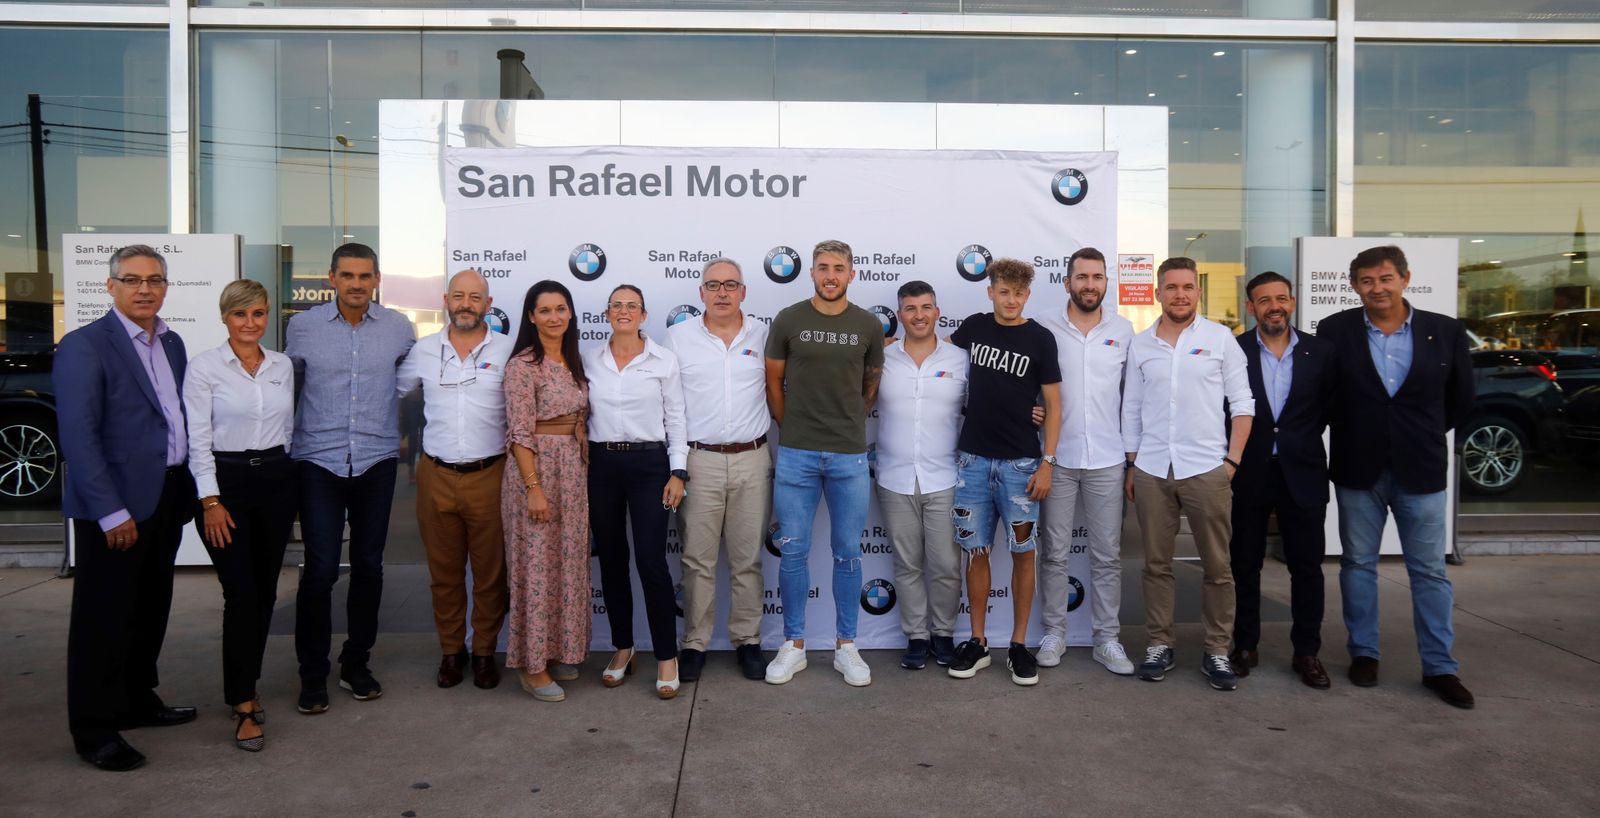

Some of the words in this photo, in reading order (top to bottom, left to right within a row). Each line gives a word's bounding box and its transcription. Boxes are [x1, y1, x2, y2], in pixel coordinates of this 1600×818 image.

[458, 165, 535, 198] San
[549, 163, 673, 197] Rafael
[687, 165, 807, 198] Motor
[75, 245, 95, 255] San
[97, 245, 119, 255] Rafa
[163, 245, 183, 254] S.L.
[452, 250, 480, 262] San
[484, 250, 527, 262] Rafael
[648, 250, 675, 262] San
[853, 256, 869, 265] an
[873, 253, 916, 265] Rafael
[1034, 256, 1059, 267] San
[665, 267, 701, 279] Moto
[859, 269, 901, 282] Motor
[1311, 271, 1338, 280] BMW
[1311, 284, 1338, 293] BMW
[1405, 286, 1433, 294] recta
[1311, 296, 1338, 305] BMW
[577, 329, 609, 341] otor
[800, 330, 859, 346] GUESS
[970, 342, 1030, 378] MORATO
[860, 543, 893, 554] Moto
